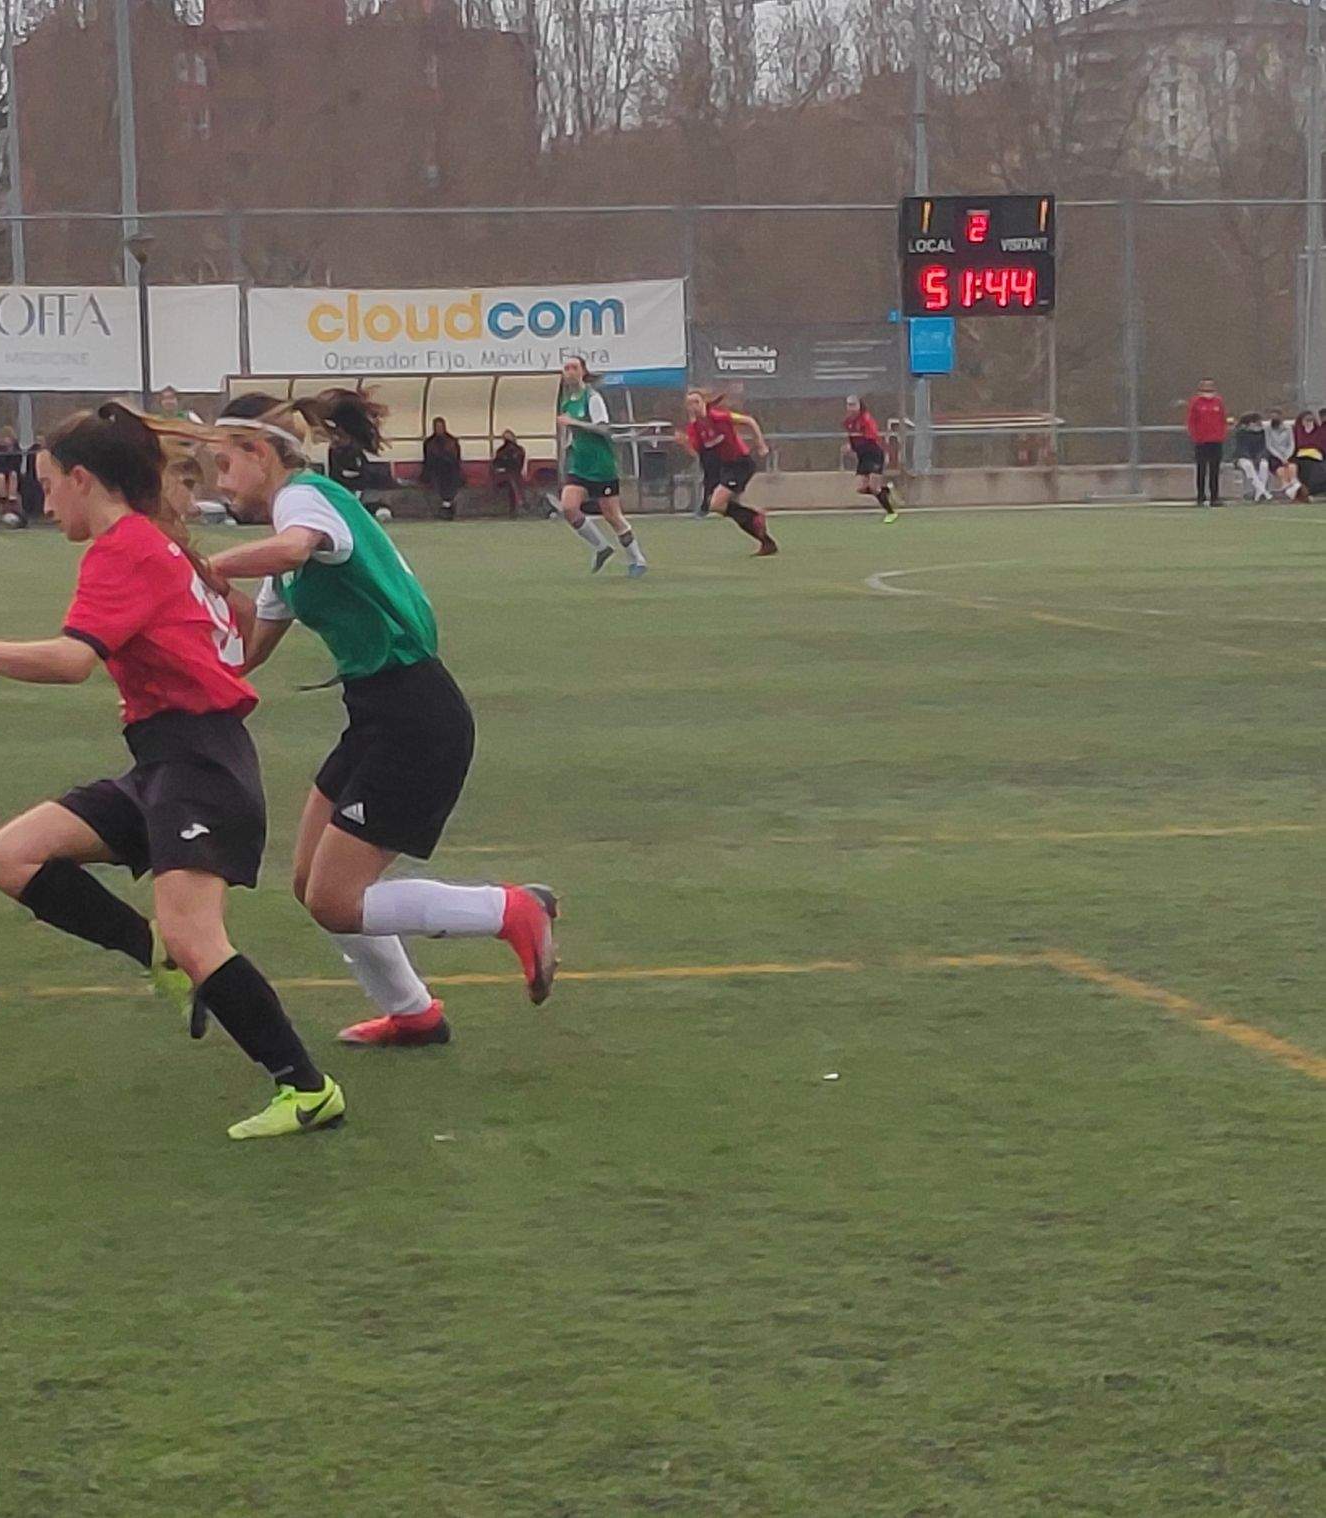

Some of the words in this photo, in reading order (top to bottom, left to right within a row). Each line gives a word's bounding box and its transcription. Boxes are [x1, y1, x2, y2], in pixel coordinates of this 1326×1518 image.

[965, 214, 990, 243] 2
[908, 238, 955, 254] LOCAL
[307, 293, 625, 343] cloudcom
[5, 351, 90, 365] MEDICINE
[324, 351, 418, 371] Operador
[426, 350, 473, 372] Fijo,
[539, 352, 552, 368] y
[558, 346, 611, 365] Fbra
